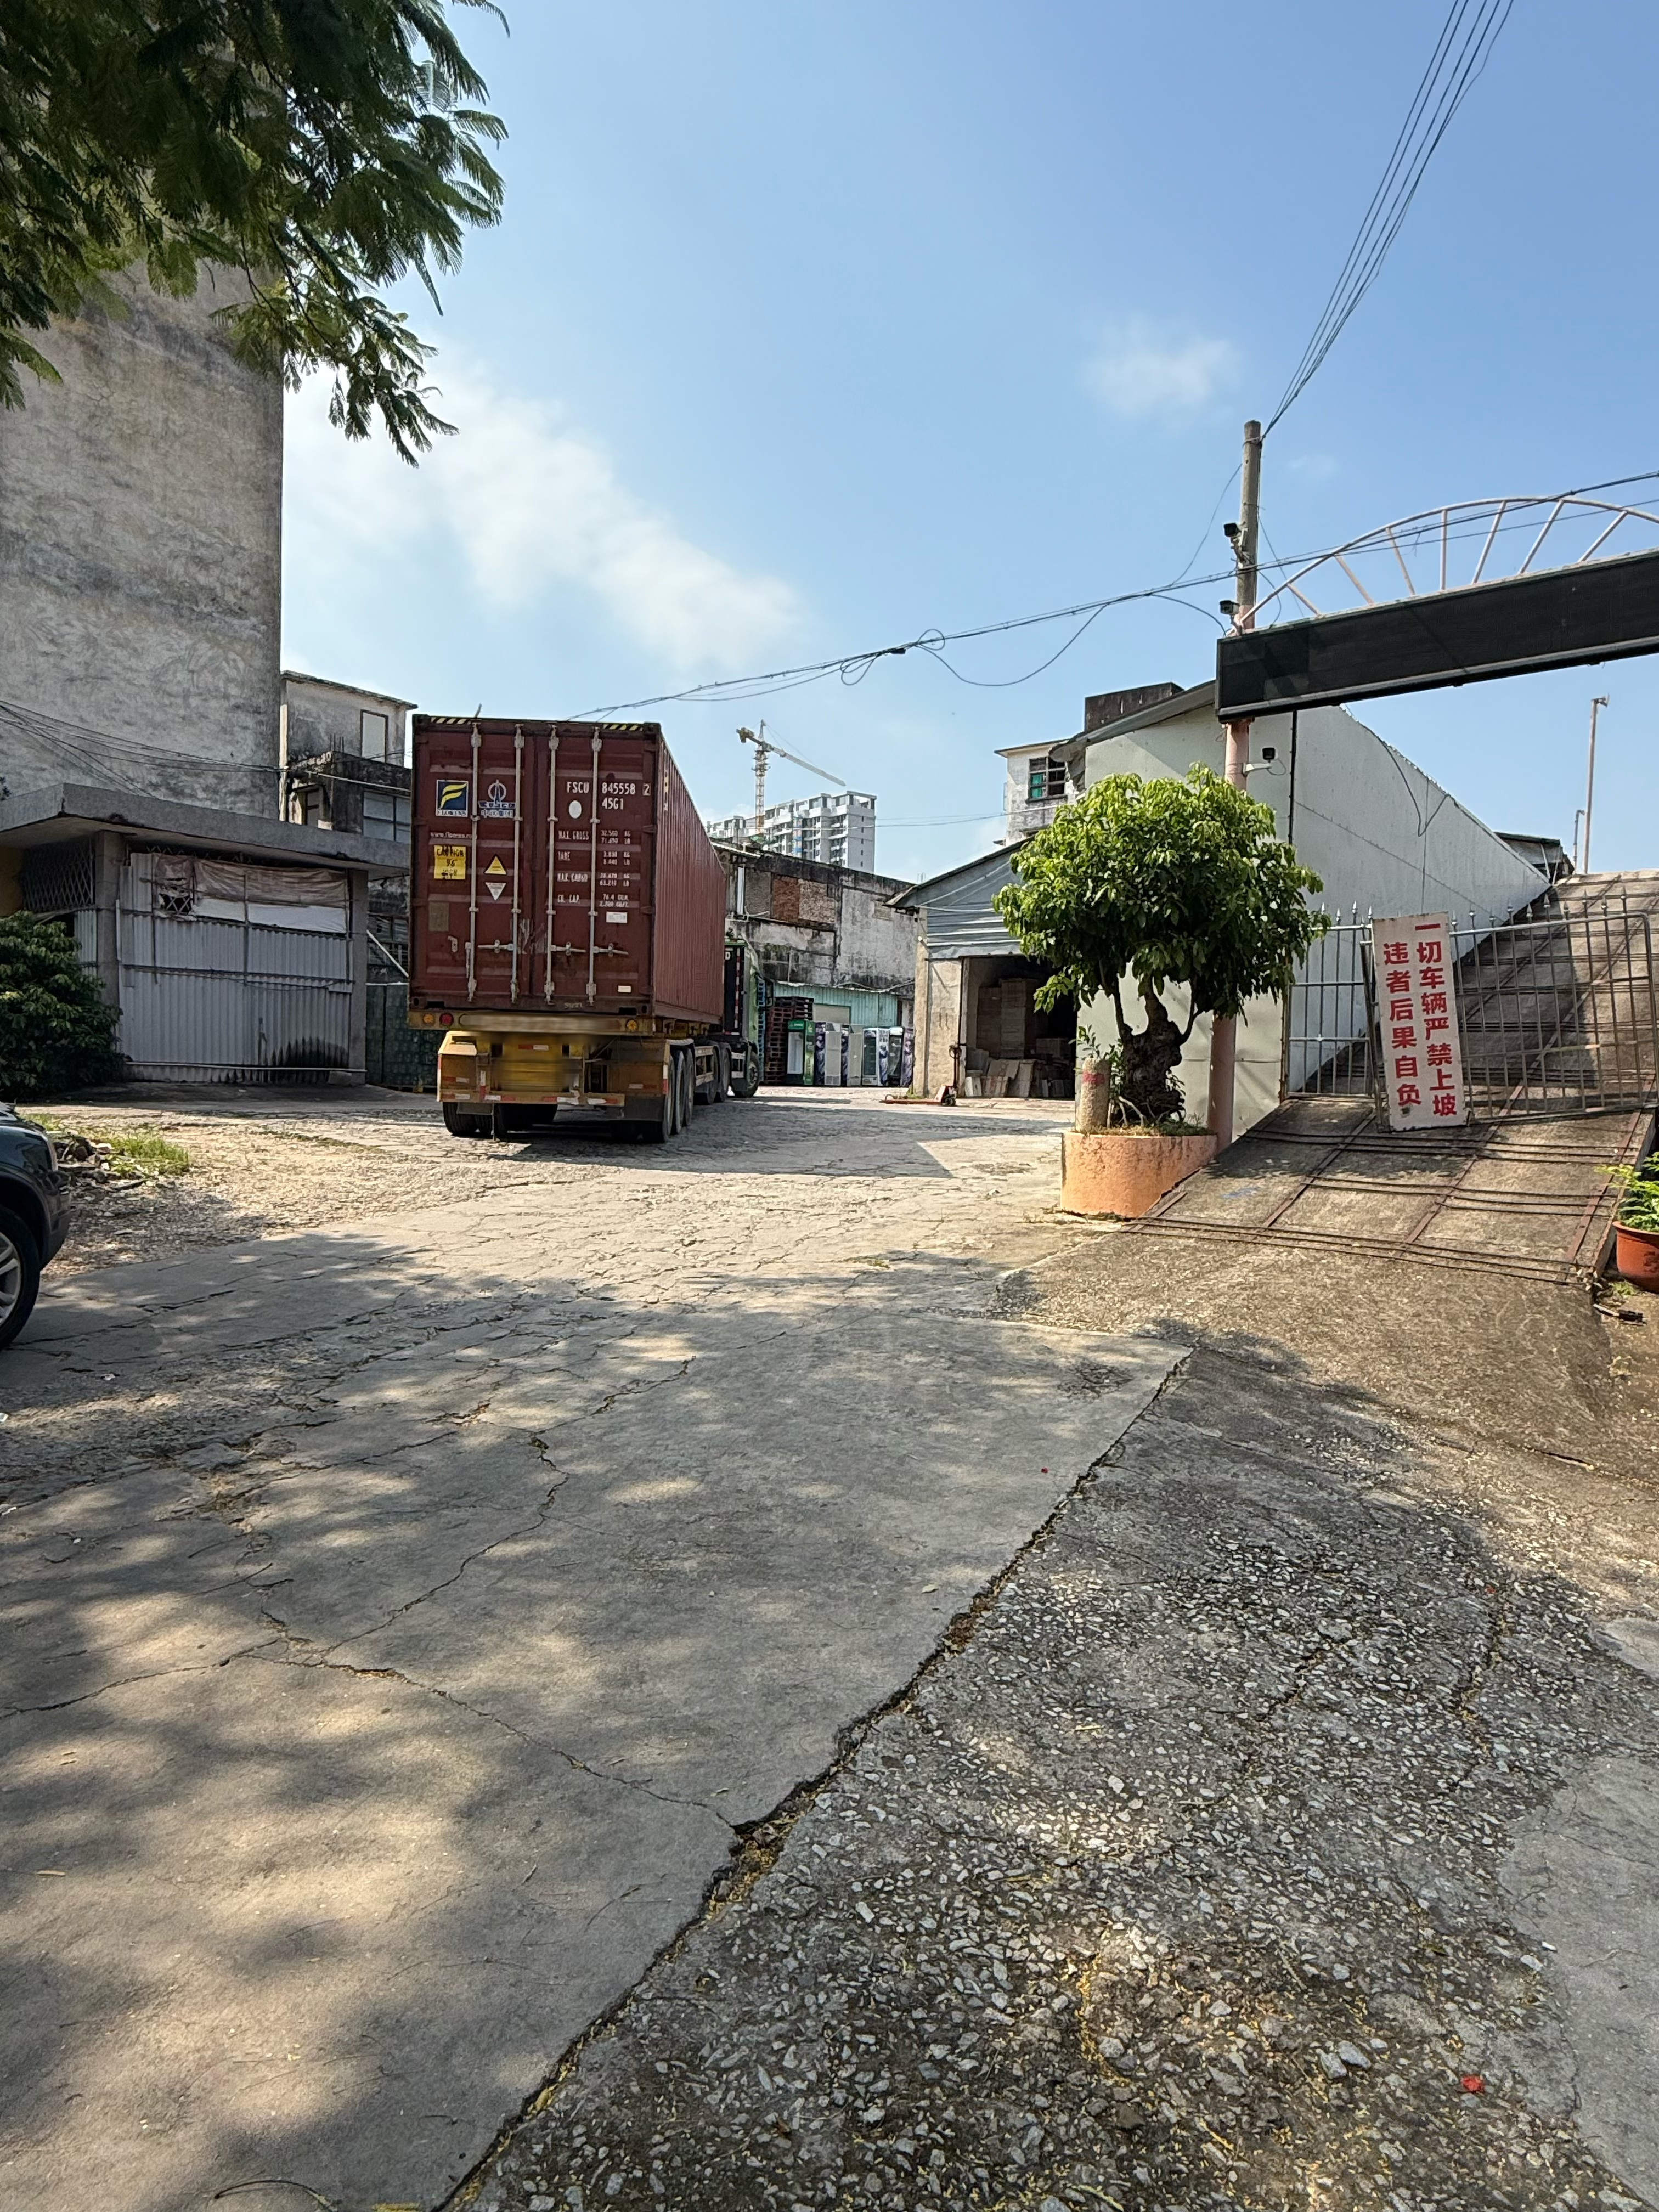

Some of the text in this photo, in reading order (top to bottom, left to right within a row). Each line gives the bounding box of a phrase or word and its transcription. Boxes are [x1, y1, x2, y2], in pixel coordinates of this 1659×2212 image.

[567, 781, 650, 795] FSCU 845558 2
[601, 797, 624, 810] 45G1
[1383, 941, 1423, 1107] 违者后果自负
[1414, 923, 1457, 1116] 一切车辆严禁上坡
